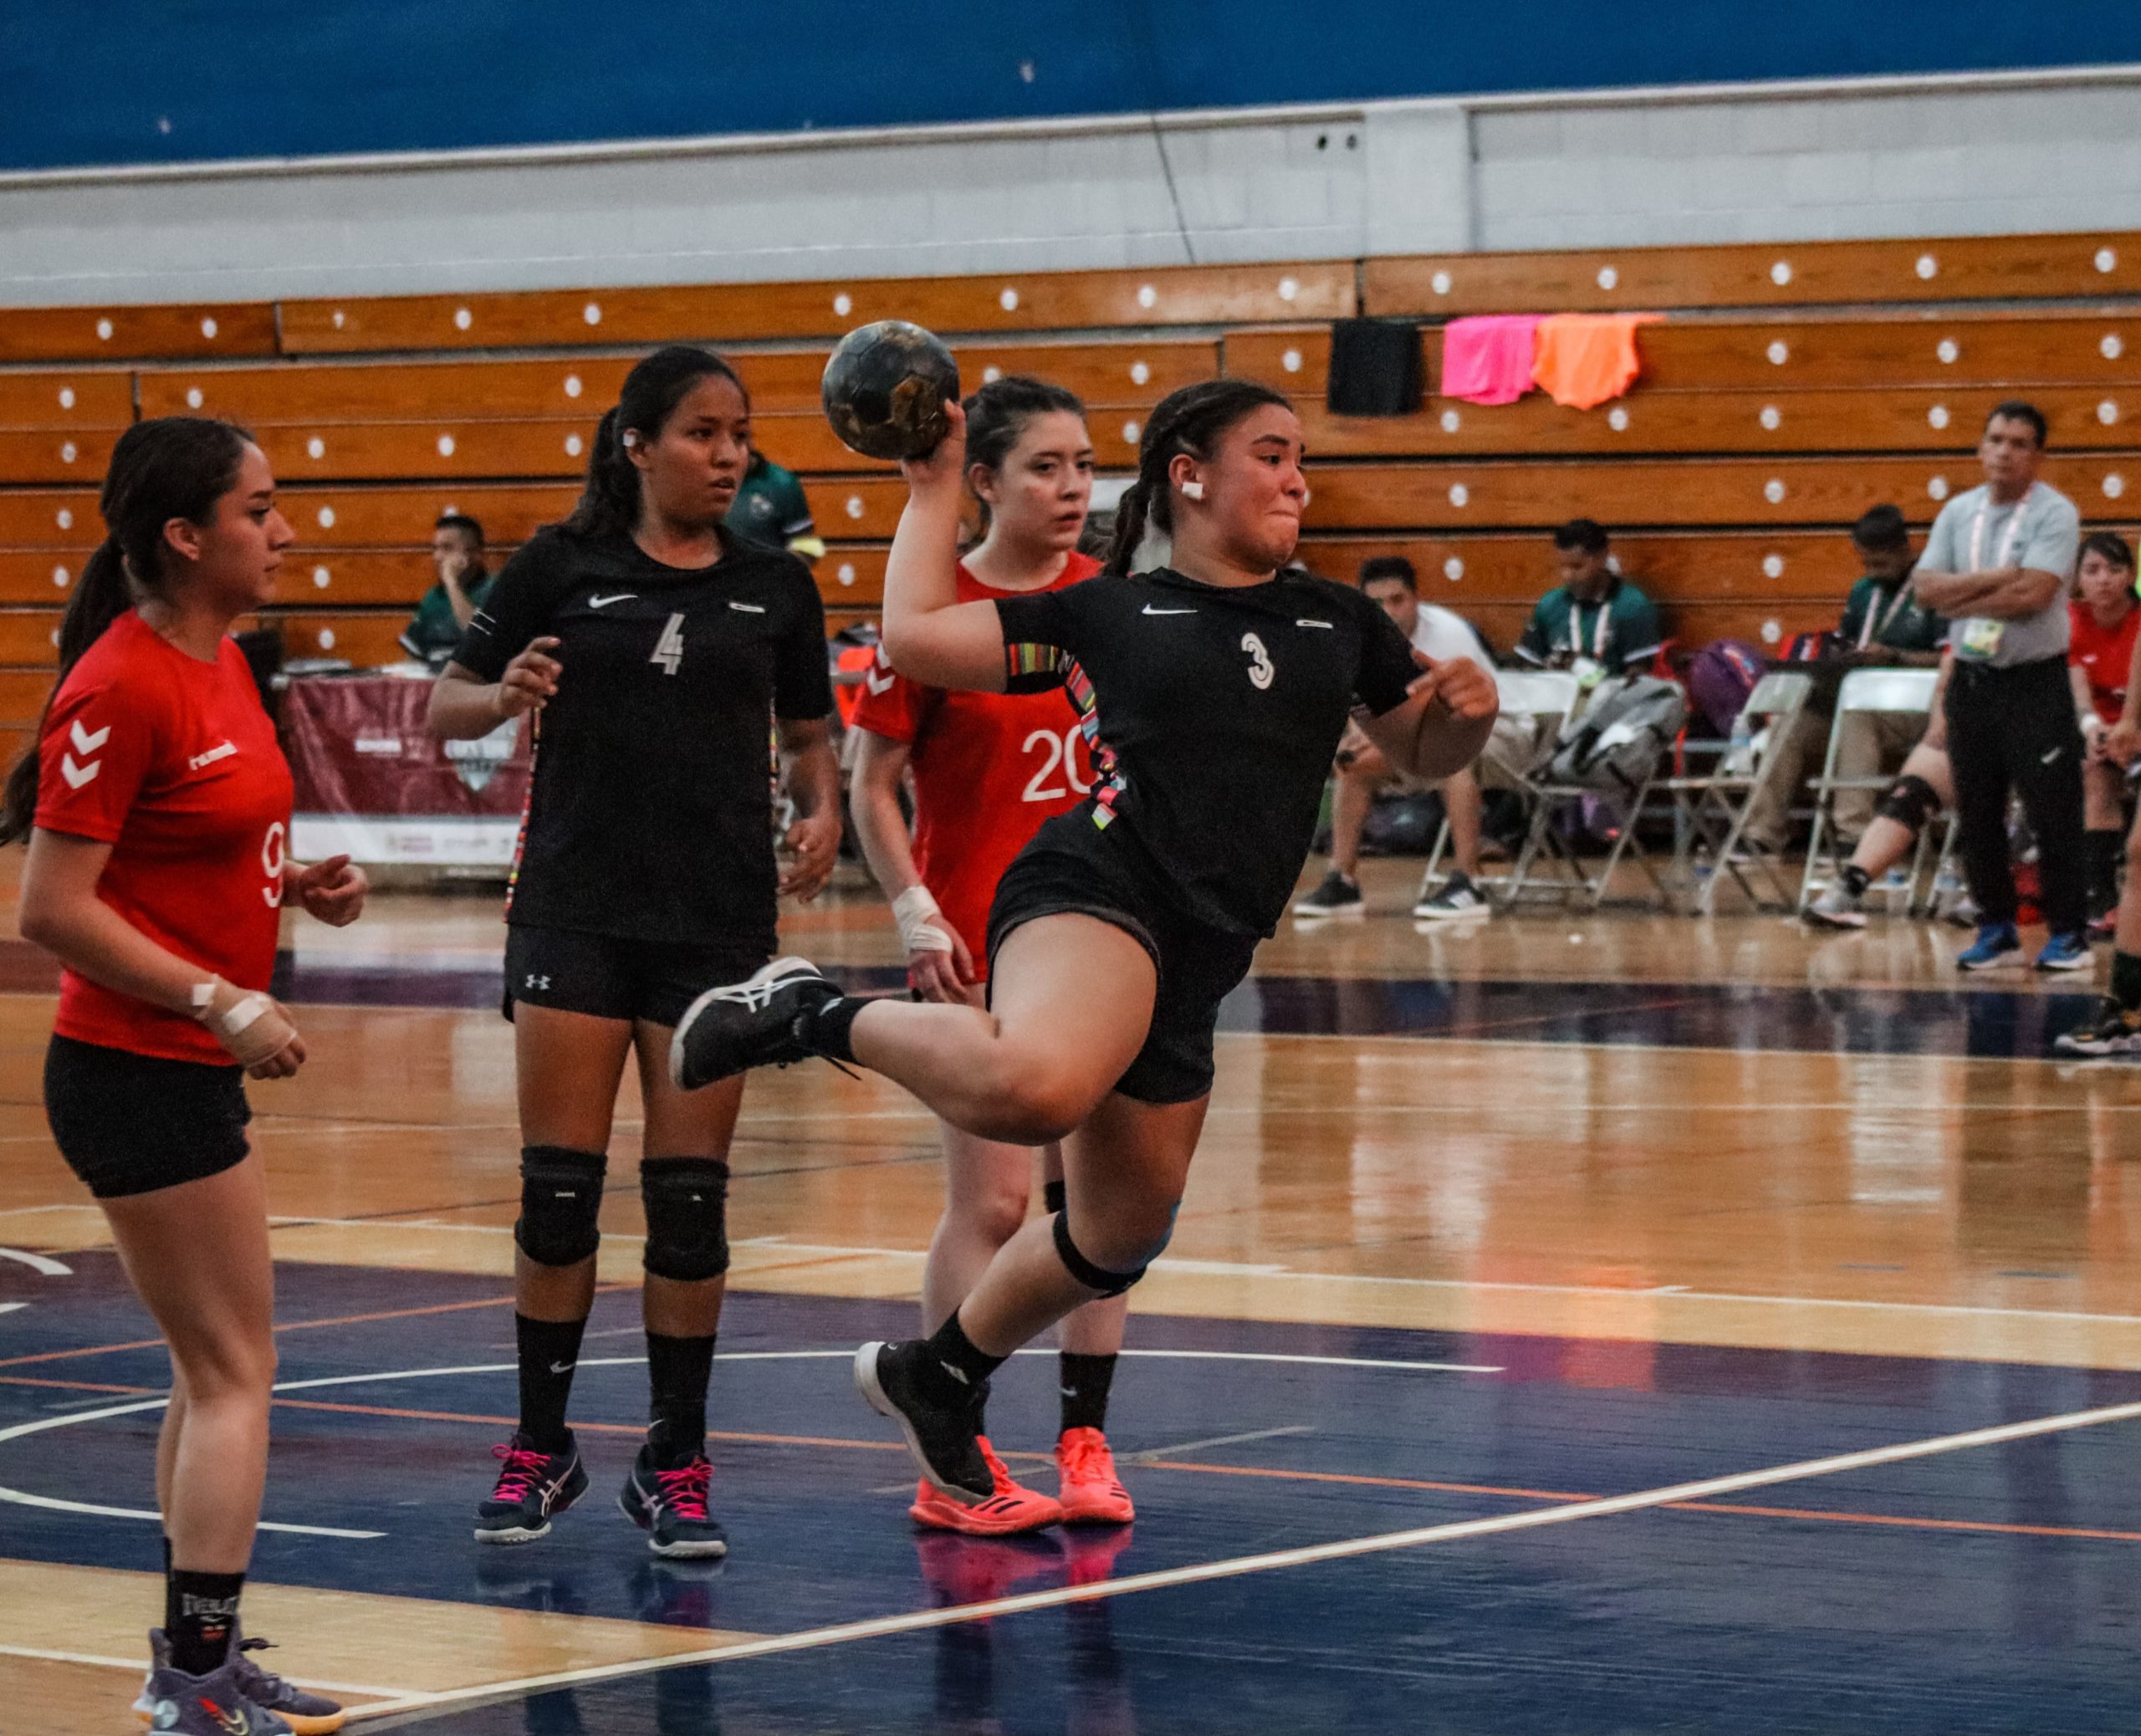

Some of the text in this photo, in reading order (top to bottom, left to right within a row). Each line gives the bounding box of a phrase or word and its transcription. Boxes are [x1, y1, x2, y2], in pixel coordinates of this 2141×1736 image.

[649, 612, 685, 676] 4
[1241, 632, 1274, 690] 3
[261, 821, 284, 908] 9
